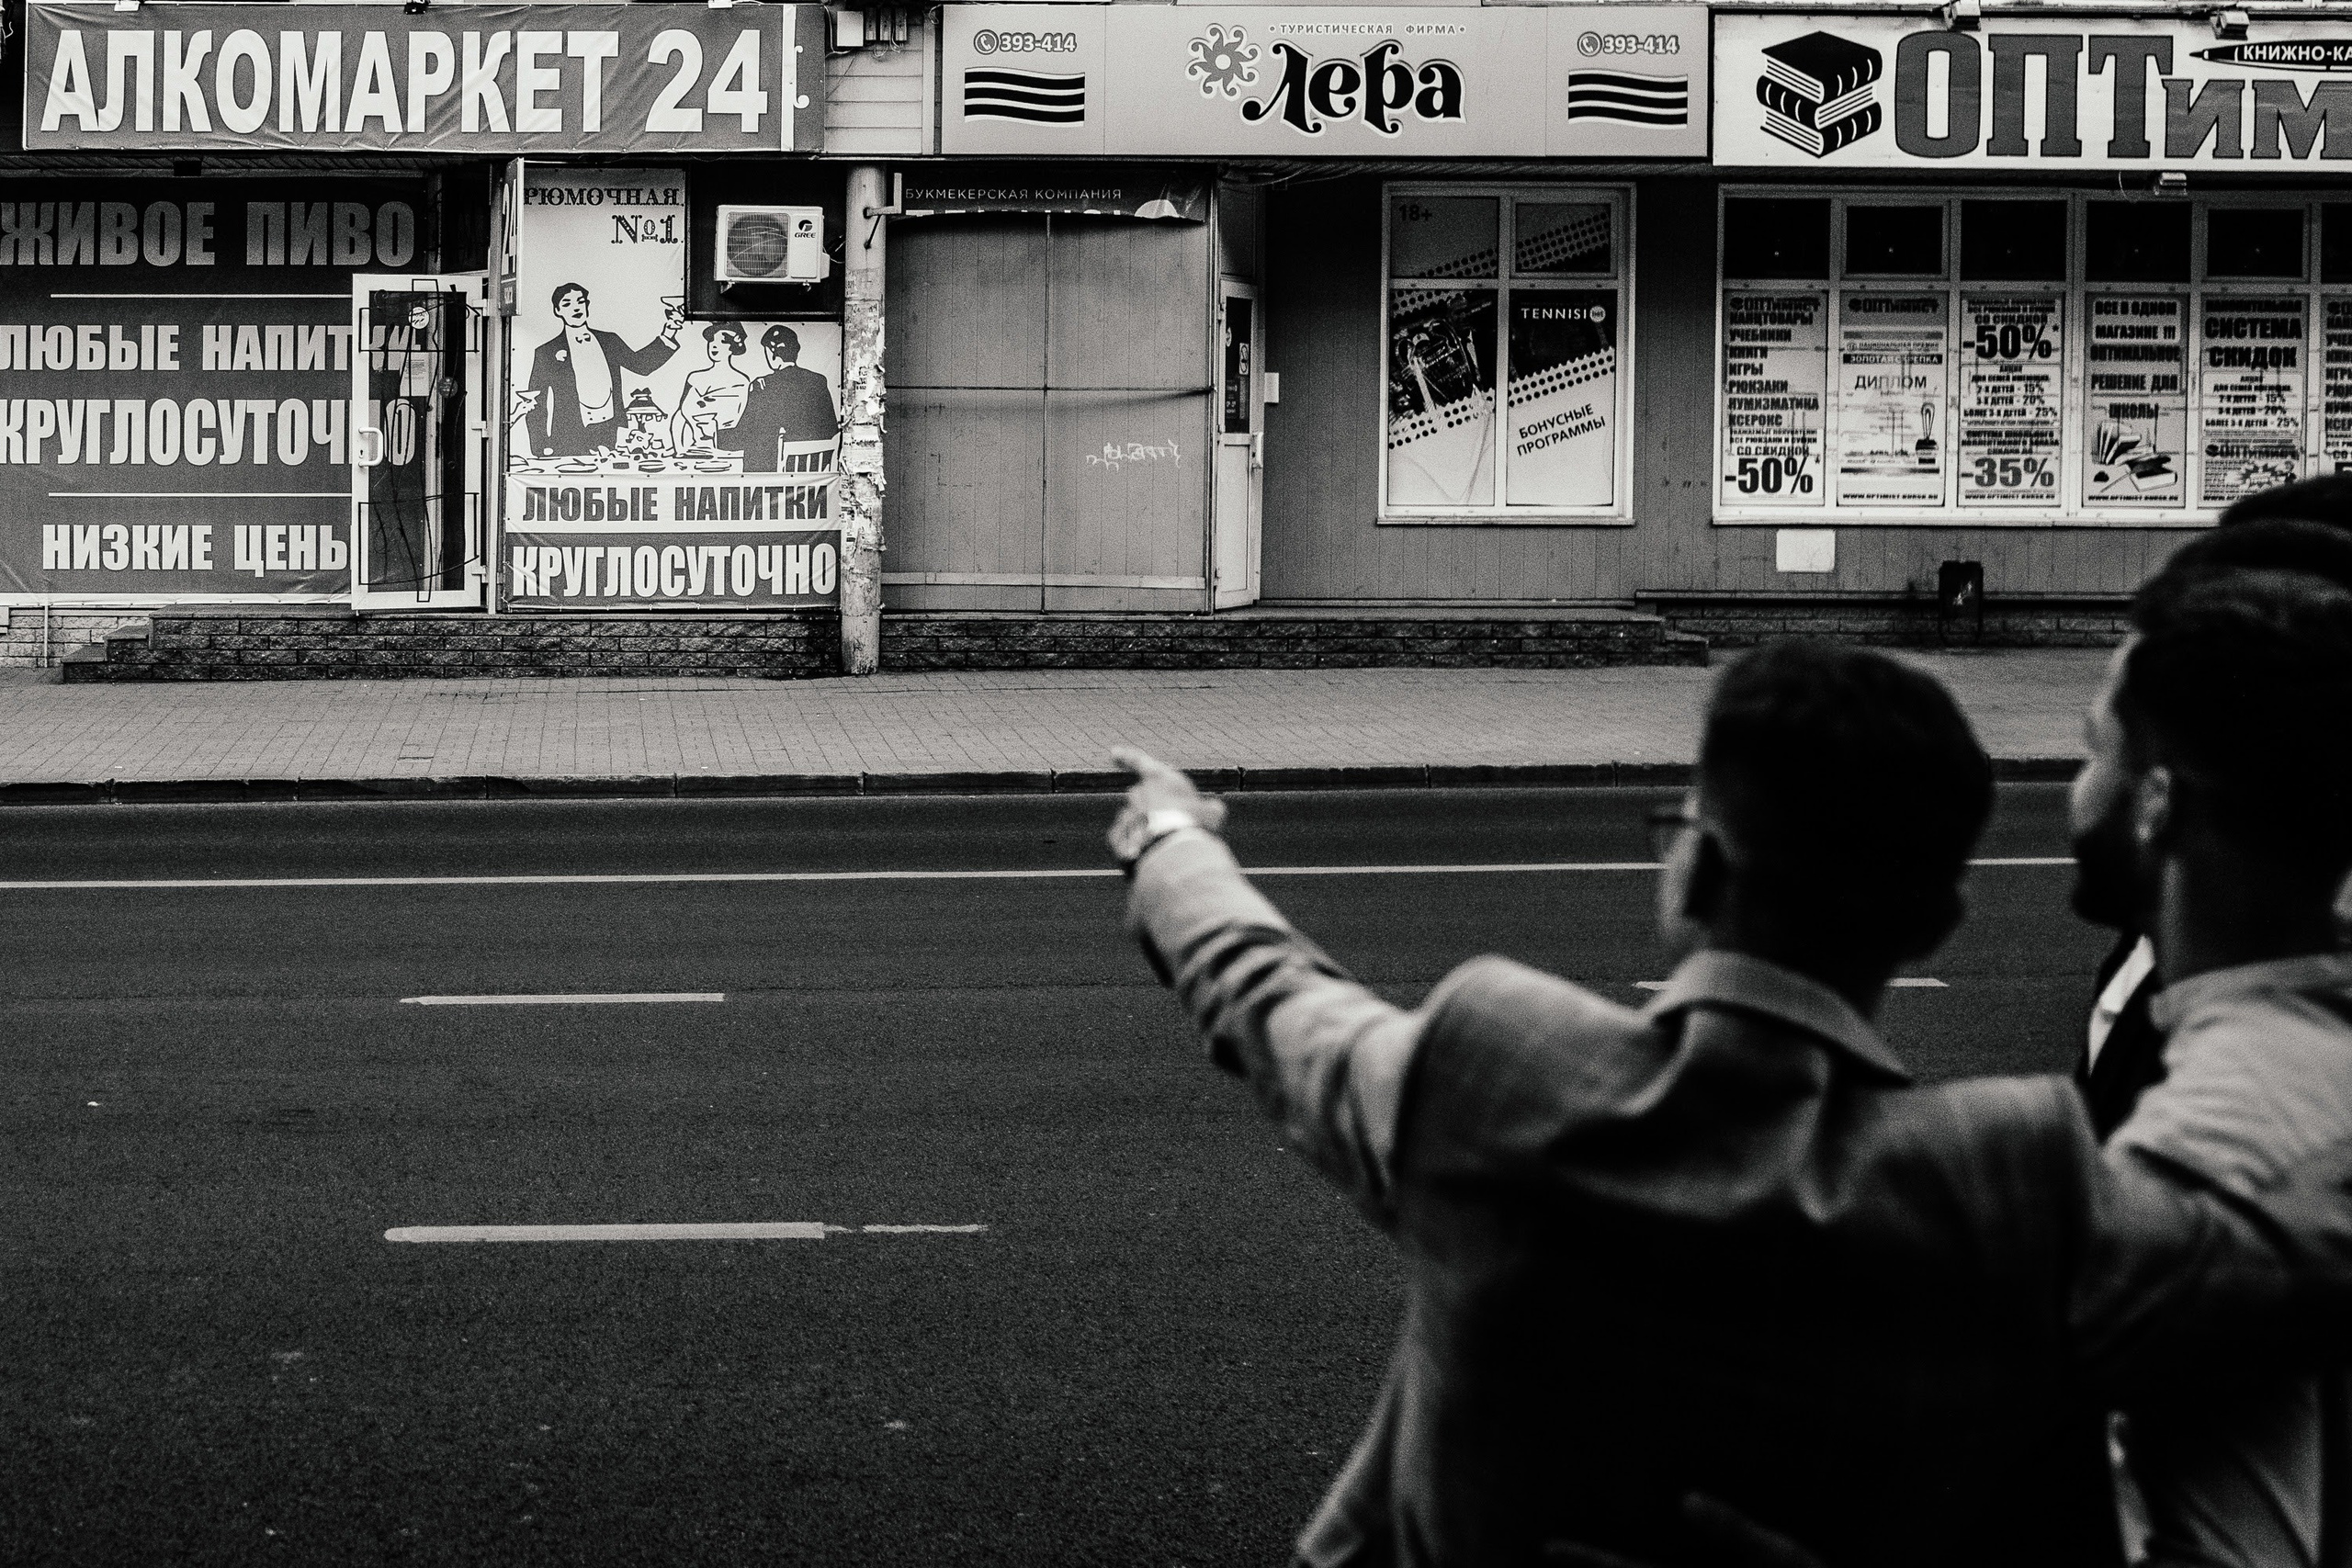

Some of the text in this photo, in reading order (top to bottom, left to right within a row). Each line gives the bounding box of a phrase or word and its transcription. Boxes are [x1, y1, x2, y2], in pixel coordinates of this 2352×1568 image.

[1280, 24, 1456, 36] ТУРИСТИЧЕСКАЯ ФИРМА
[1000, 32, 1078, 53] 393-414
[1602, 34, 1680, 55] 393-414
[40, 29, 768, 134] АЛКОМАРКЕТ 24
[1242, 41, 1465, 134] Лера
[523, 187, 680, 207] РЮМОЧНАЯ
[905, 188, 1122, 201] БУКМЕКЕРСКАЯ КОМПАНИЯ
[1398, 204, 1432, 221] 18+
[0, 201, 415, 267] ЖИВОЕ ПИВО
[1521, 308, 1587, 320] TENNISI
[2095, 301, 2177, 317] ВСЕ В ОДНОМ
[1729, 312, 1814, 325] КАНЦТОВАРЫ
[1974, 314, 2048, 324] СО СКИДКОЙ
[1729, 329, 1792, 342] УЧЕБНИКИ
[2095, 325, 2158, 339] МАГАЗИНЕ
[2205, 317, 2302, 339] СИСТЕМА
[0, 325, 180, 371] ЛЮБЫЕ
[1962, 325, 2052, 359] -50%
[1729, 345, 1769, 359] КНИГИ
[2090, 345, 2181, 362] ОПТИМАЛЬНОЕ
[2209, 345, 2297, 370] СКИДОК
[1729, 363, 1764, 377] ИГРЫ
[1728, 379, 1789, 394] РЮКЗАКИ
[1854, 375, 1928, 390] ДИПЛОМ
[2091, 374, 2178, 393] РЕШЕНИЕ ДЛЯ
[1727, 397, 1820, 412] НУМИЗМАТИКА
[2109, 403, 2159, 419] ШКОЛЫ
[1519, 403, 1594, 439] БОНУСНЫЕ
[1728, 413, 1783, 427] КСЕРОКС
[1516, 416, 1606, 457] ПРОГРАММЫ
[1736, 445, 1810, 457] СО СКИДКОЙ
[1724, 457, 1814, 494] -50%
[1961, 457, 2055, 488] -35%
[522, 485, 829, 522] ЛЮБЫЕ НАПИТКИ
[42, 525, 213, 570] НИЗКИЕ
[513, 543, 837, 597] КРУГЛОСУТОЧНО
